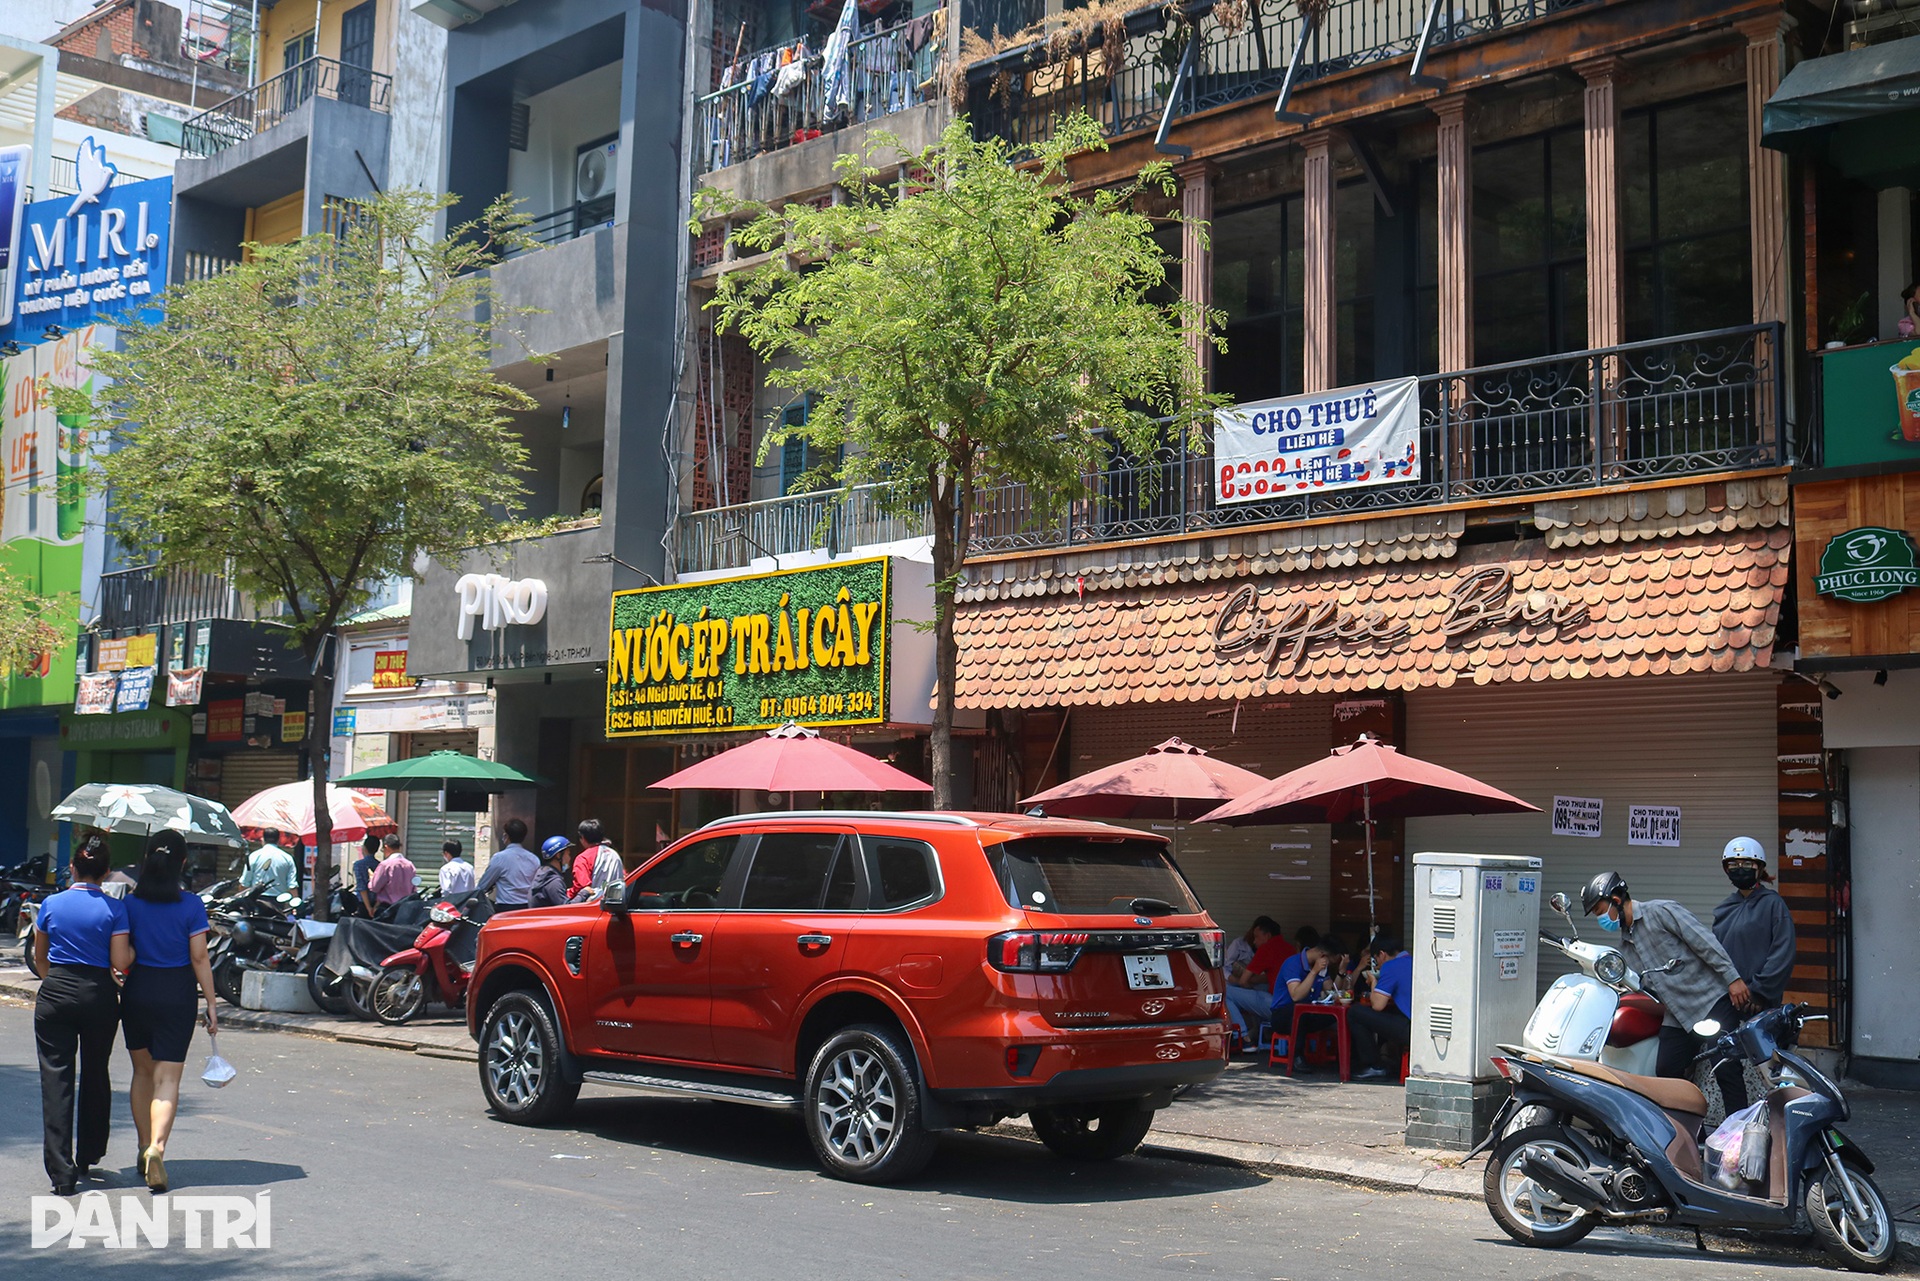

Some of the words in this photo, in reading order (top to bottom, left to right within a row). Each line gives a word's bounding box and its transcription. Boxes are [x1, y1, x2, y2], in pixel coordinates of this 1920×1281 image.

[27, 201, 149, 271] MIRI
[129, 280, 151, 295] GIA
[14, 371, 50, 418] LOVE
[1252, 407, 1301, 436] CHO
[1308, 388, 1378, 427] THUÊ
[1286, 432, 1316, 450] LIÊN
[1318, 429, 1336, 448] HỆ
[11, 431, 38, 475] LIFE
[1818, 572, 1865, 591] PHUC
[1869, 570, 1918, 584] LONG
[1212, 583, 1409, 664] Coffee
[1441, 566, 1588, 637] Bar
[610, 608, 690, 685] NƯỚC
[691, 605, 729, 679] ÉP
[731, 592, 811, 676] TRÁI
[812, 585, 879, 667] CÂY
[375, 655, 388, 670] CHO
[612, 688, 634, 706] CS1:
[634, 688, 646, 704] 48
[647, 683, 668, 703] NGÔ
[668, 681, 689, 702] ĐỨC
[706, 680, 723, 698] Q.1
[611, 709, 632, 728] CS2:
[633, 709, 651, 727] 66A
[653, 700, 692, 726] NGUYỄN
[692, 706, 716, 728] HUỆ,
[716, 706, 733, 725] Q.1
[760, 699, 782, 718] ĐT:
[784, 694, 816, 716] 0964
[819, 694, 843, 713] 804
[847, 691, 873, 712] 334
[69, 723, 88, 741] LOVE
[89, 721, 112, 740] FROM
[114, 718, 160, 739] AUSTRALIA
[1557, 799, 1569, 807] CHO
[1588, 800, 1600, 810] NHÀ
[1633, 808, 1646, 816] CHO
[1665, 809, 1679, 817] NHÀ
[1096, 933, 1196, 942] EVEREST
[596, 1020, 633, 1029] TITANIUM
[1054, 1011, 1110, 1019] TITANIUM
[1545, 1069, 1590, 1087] VISION
[1792, 1109, 1813, 1117] HONDA
